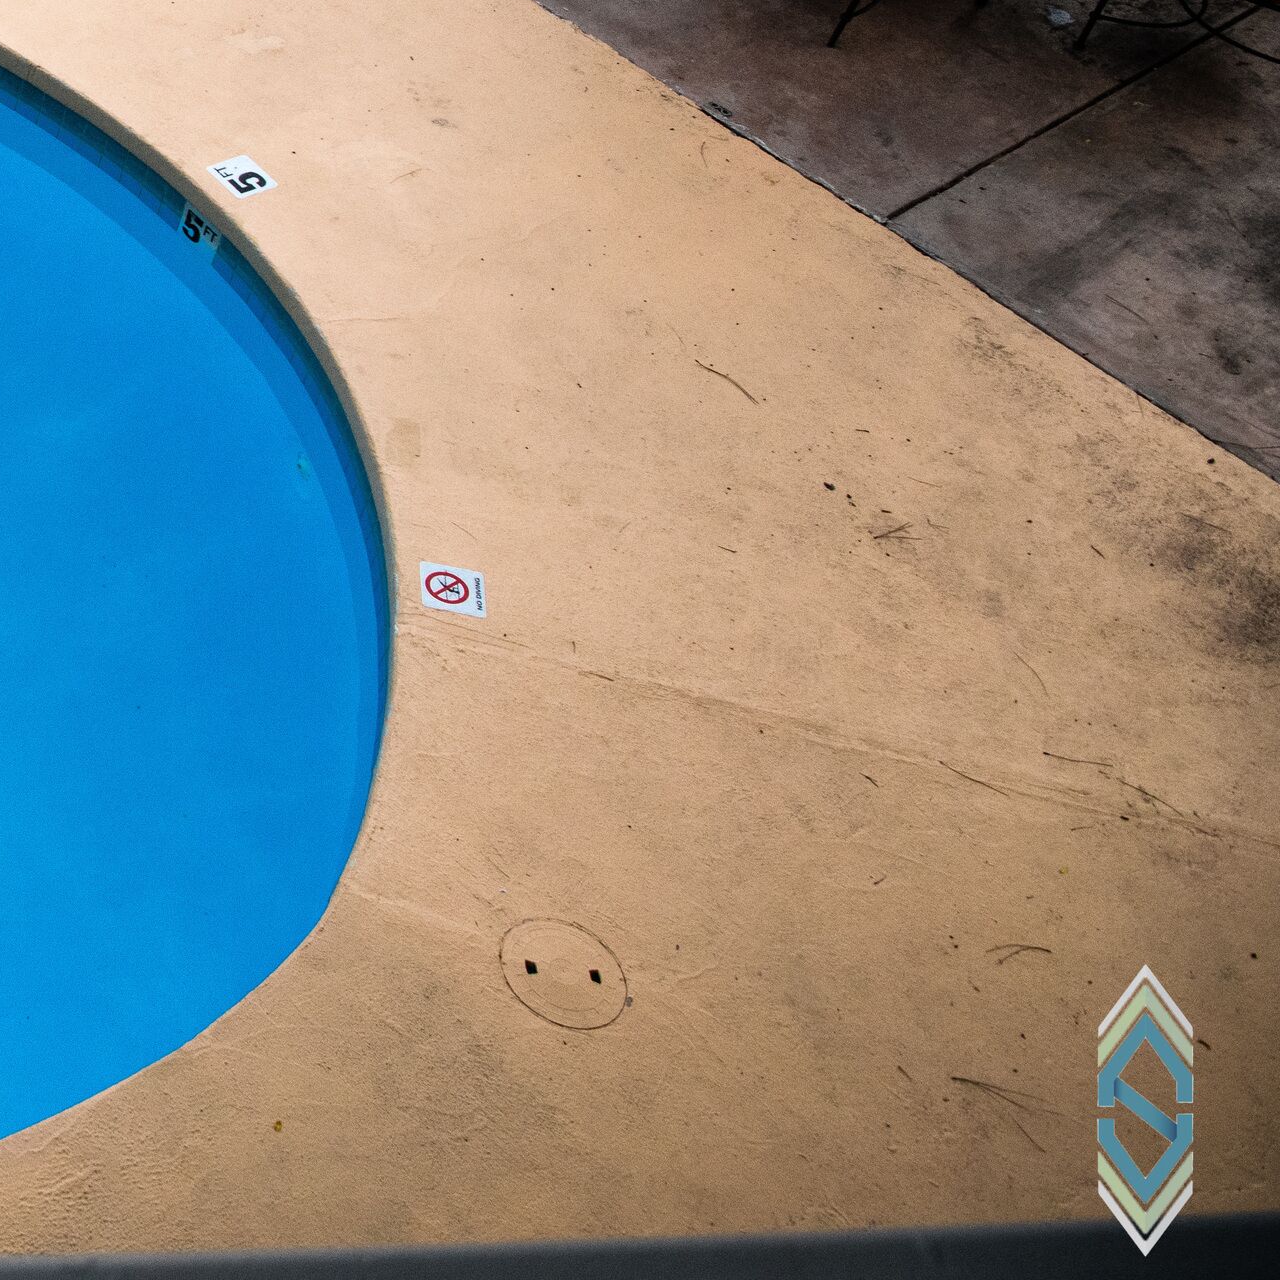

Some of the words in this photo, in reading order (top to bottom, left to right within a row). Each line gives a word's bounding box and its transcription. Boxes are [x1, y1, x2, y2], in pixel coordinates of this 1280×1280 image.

[213, 166, 234, 179] FT
[227, 171, 267, 194] 5
[182, 208, 204, 244] 5
[203, 225, 218, 243] FT
[474, 577, 483, 600] DIVING
[477, 600, 483, 611] NO
